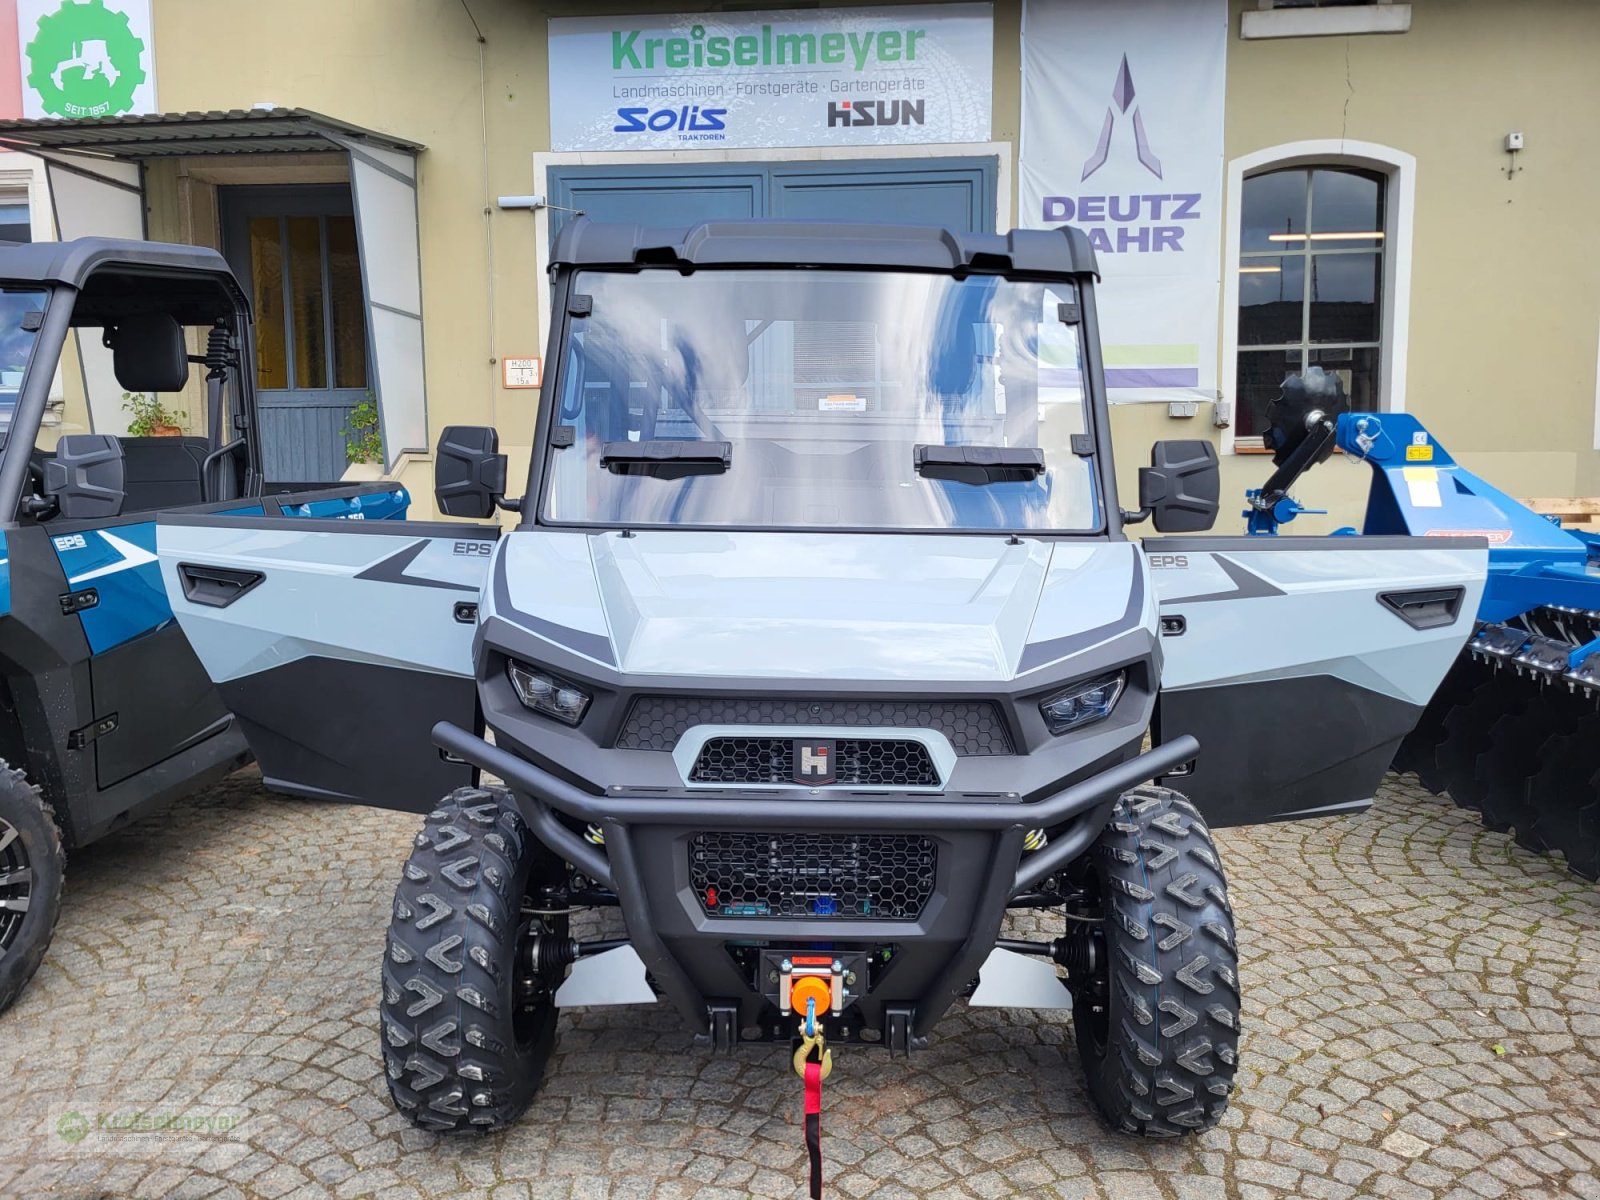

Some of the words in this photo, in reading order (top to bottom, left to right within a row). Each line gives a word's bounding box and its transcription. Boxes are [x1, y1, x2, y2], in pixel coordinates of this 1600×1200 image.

[612, 24, 926, 71] Kreiselmeyer
[613, 83, 724, 98] Landmaschinen
[736, 80, 818, 96] Forstgeräte
[830, 78, 925, 93] Gartengeräte
[64, 102, 87, 116] SEIT
[88, 101, 110, 116] 1857
[613, 105, 728, 132] Solis
[1042, 193, 1202, 223] DEUTZ
[1087, 226, 1185, 253] AHR
[54, 534, 86, 549] EPS
[453, 541, 492, 555] EPS
[1149, 555, 1189, 567] EPS
